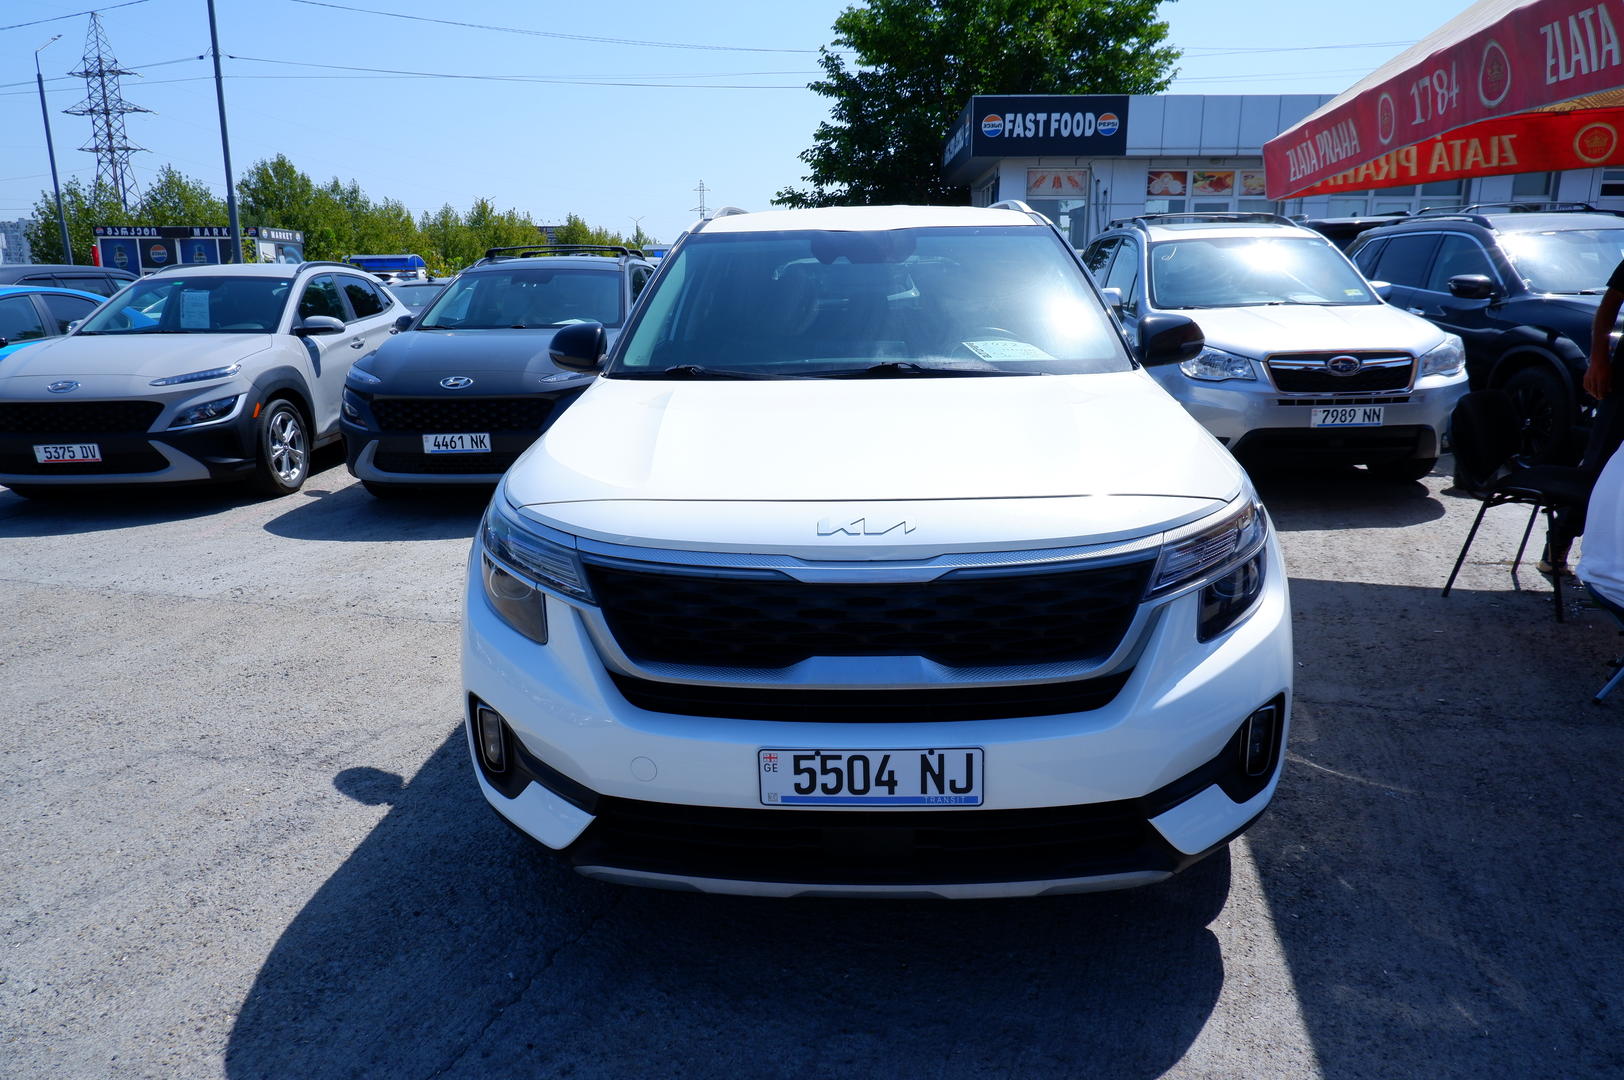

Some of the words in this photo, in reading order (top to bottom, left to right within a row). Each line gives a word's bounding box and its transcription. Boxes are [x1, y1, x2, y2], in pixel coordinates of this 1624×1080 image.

[1410, 60, 1460, 125] 1784
[1004, 113, 1048, 138] FAST
[1050, 112, 1096, 137] FOOD
[1286, 129, 1319, 182] ZLATÁ
[1316, 118, 1361, 169] PRAHA
[193, 227, 246, 237] MARKT
[270, 231, 293, 240] MARKET
[1322, 408, 1357, 424] 7989
[1363, 408, 1381, 423] NN
[433, 435, 464, 450] 4461
[470, 434, 487, 449] NK
[43, 446, 76, 460] 5375
[80, 445, 96, 459] DV
[763, 763, 778, 773] GE
[792, 754, 898, 796] 5504
[920, 753, 974, 795] NJ
[925, 796, 966, 804] TRANSIT
